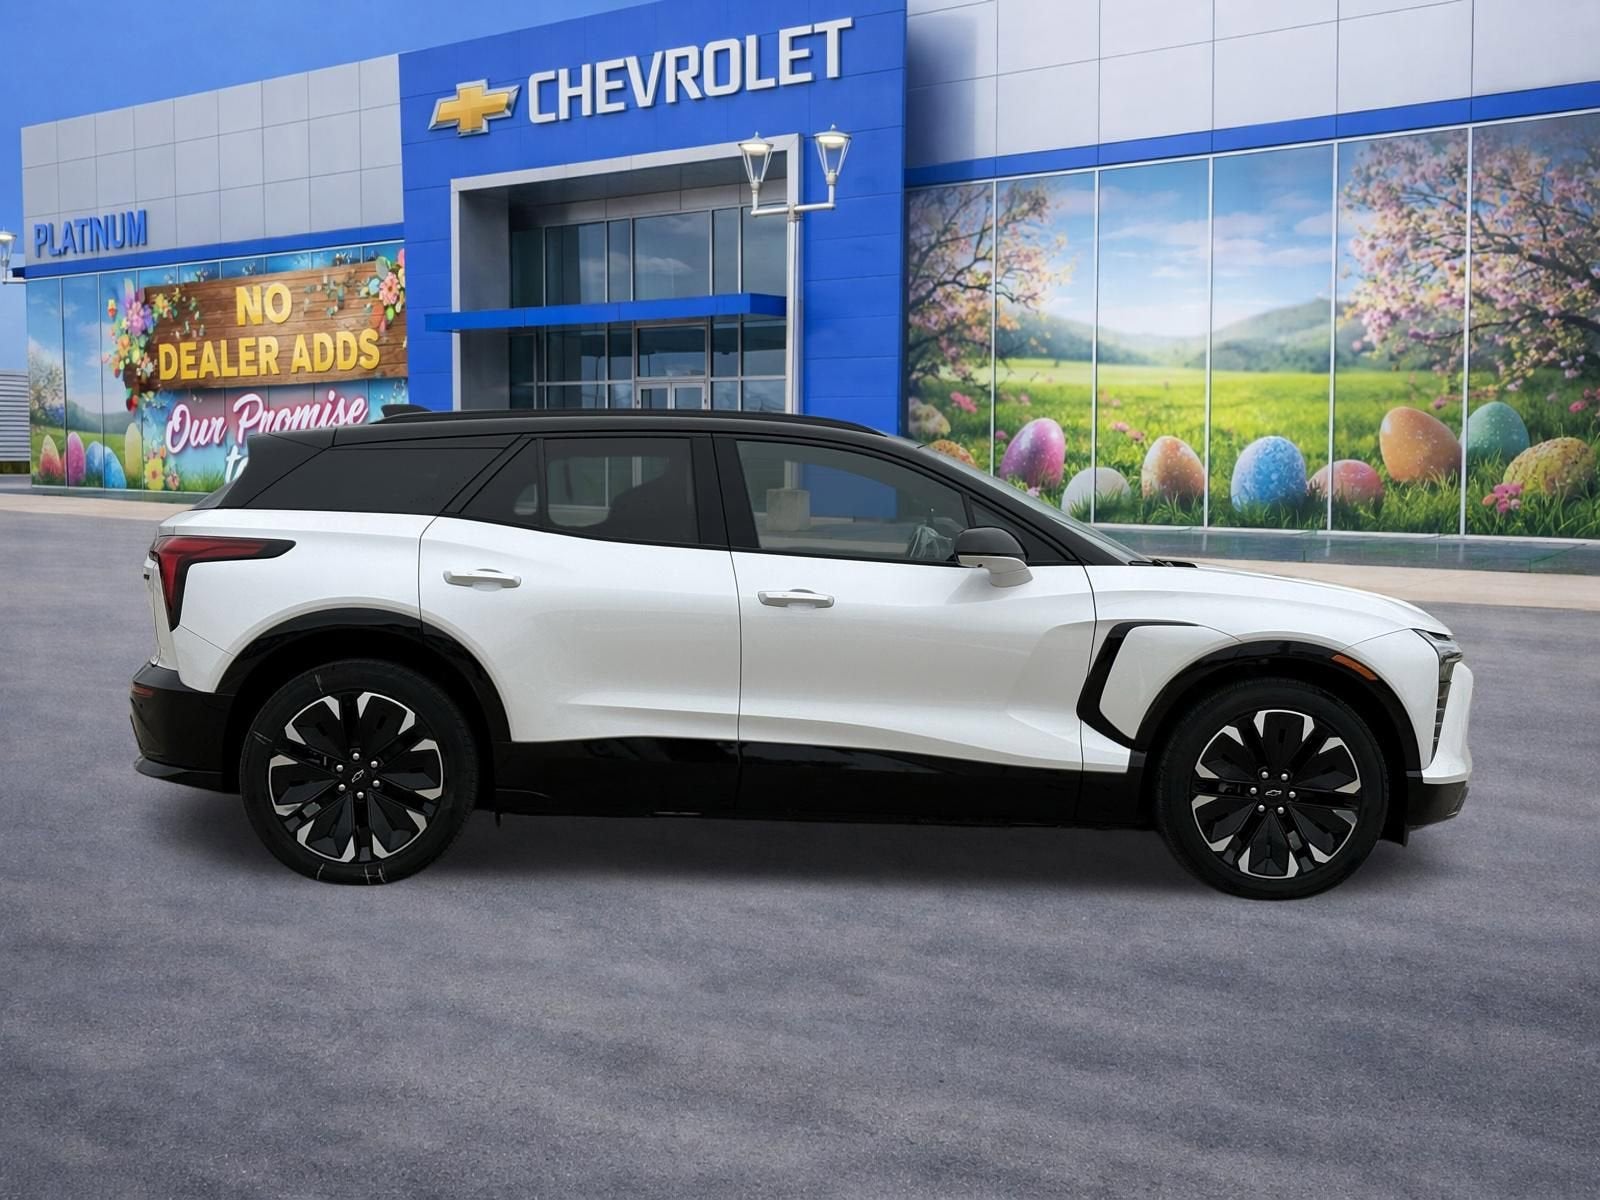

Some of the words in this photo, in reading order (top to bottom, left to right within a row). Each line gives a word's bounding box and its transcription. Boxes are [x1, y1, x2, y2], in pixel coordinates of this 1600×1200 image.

[528, 17, 853, 124] CHEVROLET
[34, 209, 148, 257] PLATINUM
[235, 283, 292, 325] NO
[158, 336, 279, 380] DEALER
[291, 328, 381, 373] ADDS
[165, 404, 227, 453] Our
[233, 390, 368, 444] Promise
